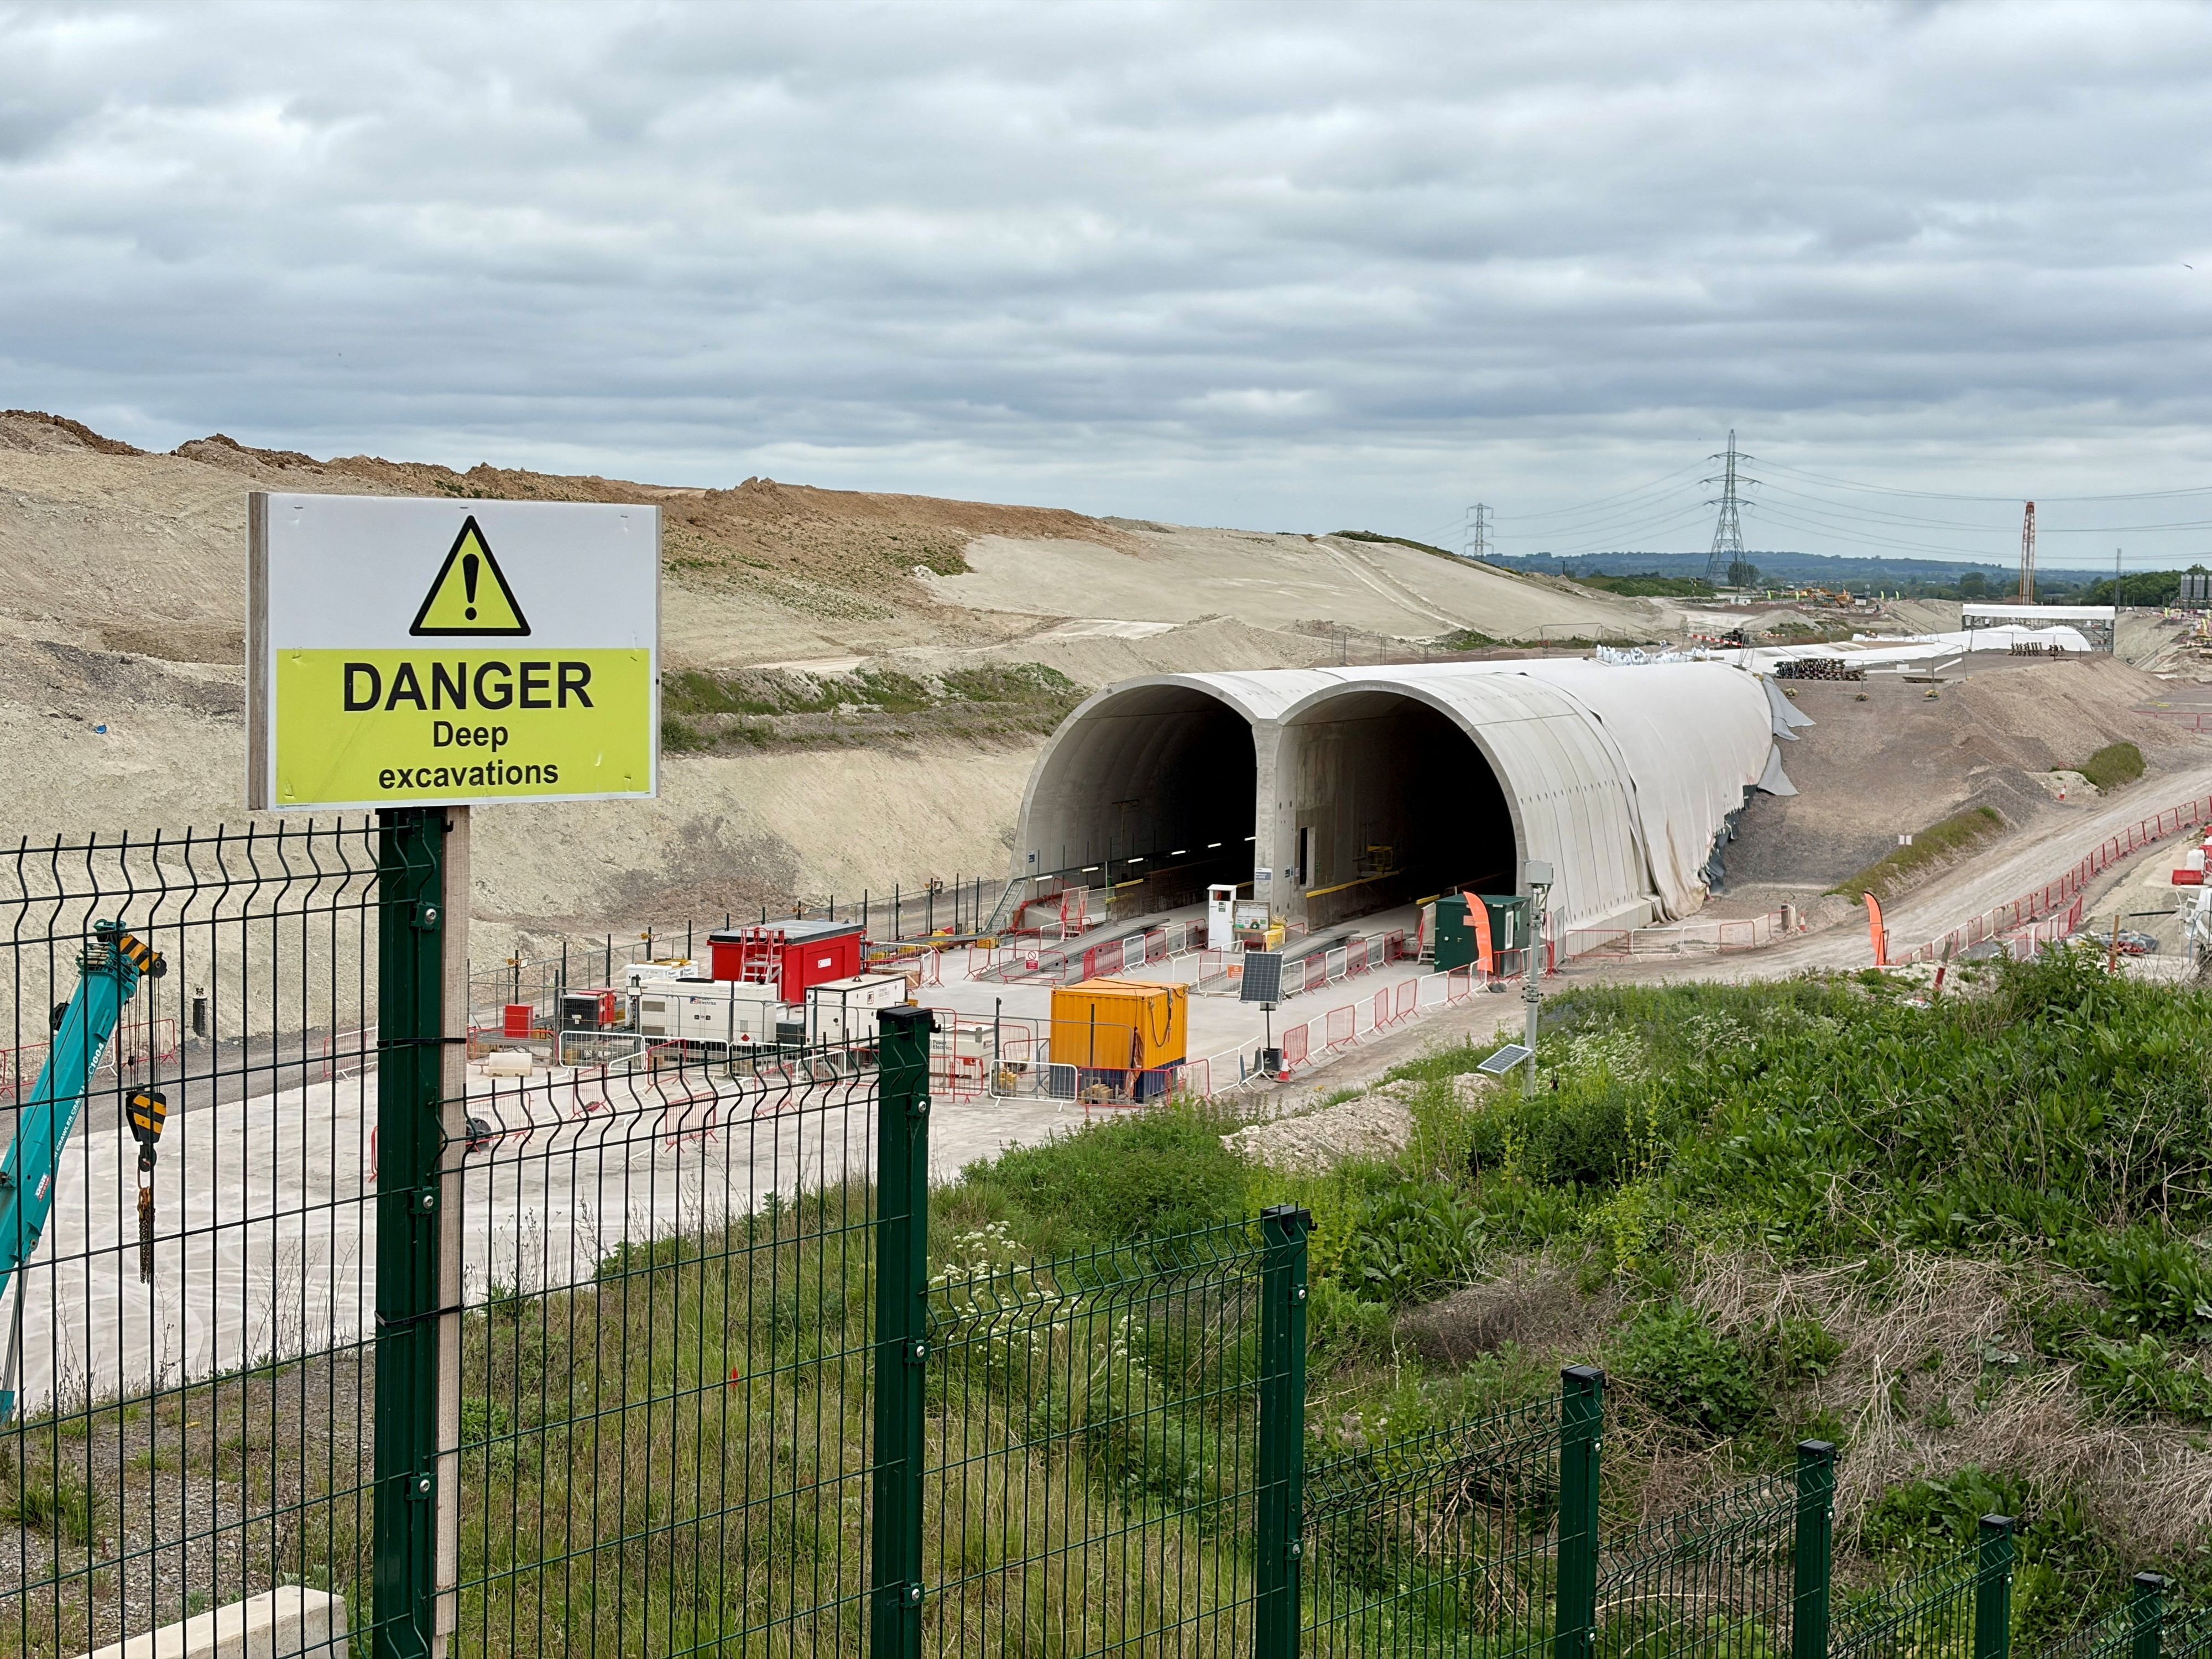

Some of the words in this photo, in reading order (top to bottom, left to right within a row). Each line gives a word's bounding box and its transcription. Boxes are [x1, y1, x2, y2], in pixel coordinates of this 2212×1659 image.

[343, 661, 594, 712] DANGER
[432, 720, 509, 753] Deep
[378, 759, 559, 789] excavations
[56, 1114, 73, 1151] CRAWLER
